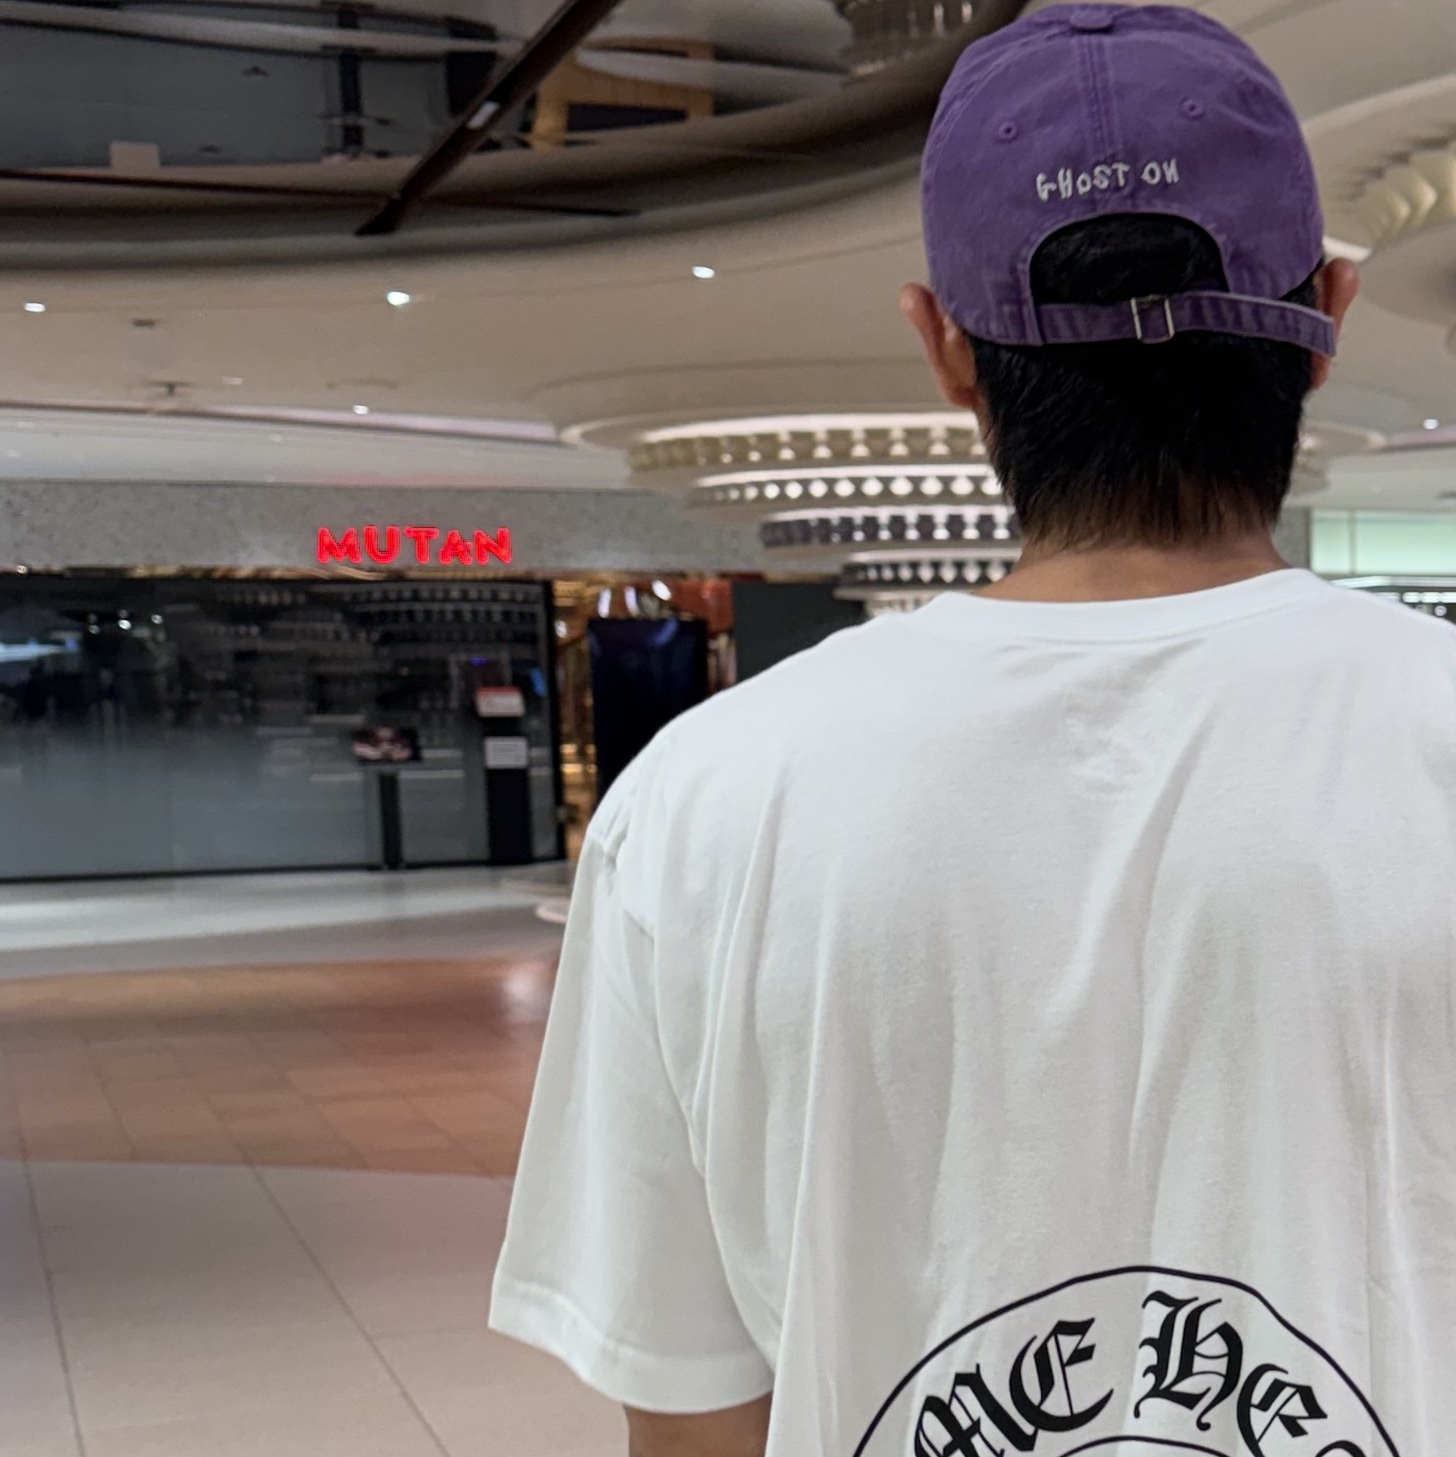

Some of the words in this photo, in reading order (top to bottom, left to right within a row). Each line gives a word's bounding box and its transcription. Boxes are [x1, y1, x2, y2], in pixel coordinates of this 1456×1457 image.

[1036, 161, 1131, 202] GHOST
[1141, 157, 1180, 185] ON
[317, 525, 513, 565] MUTAN
